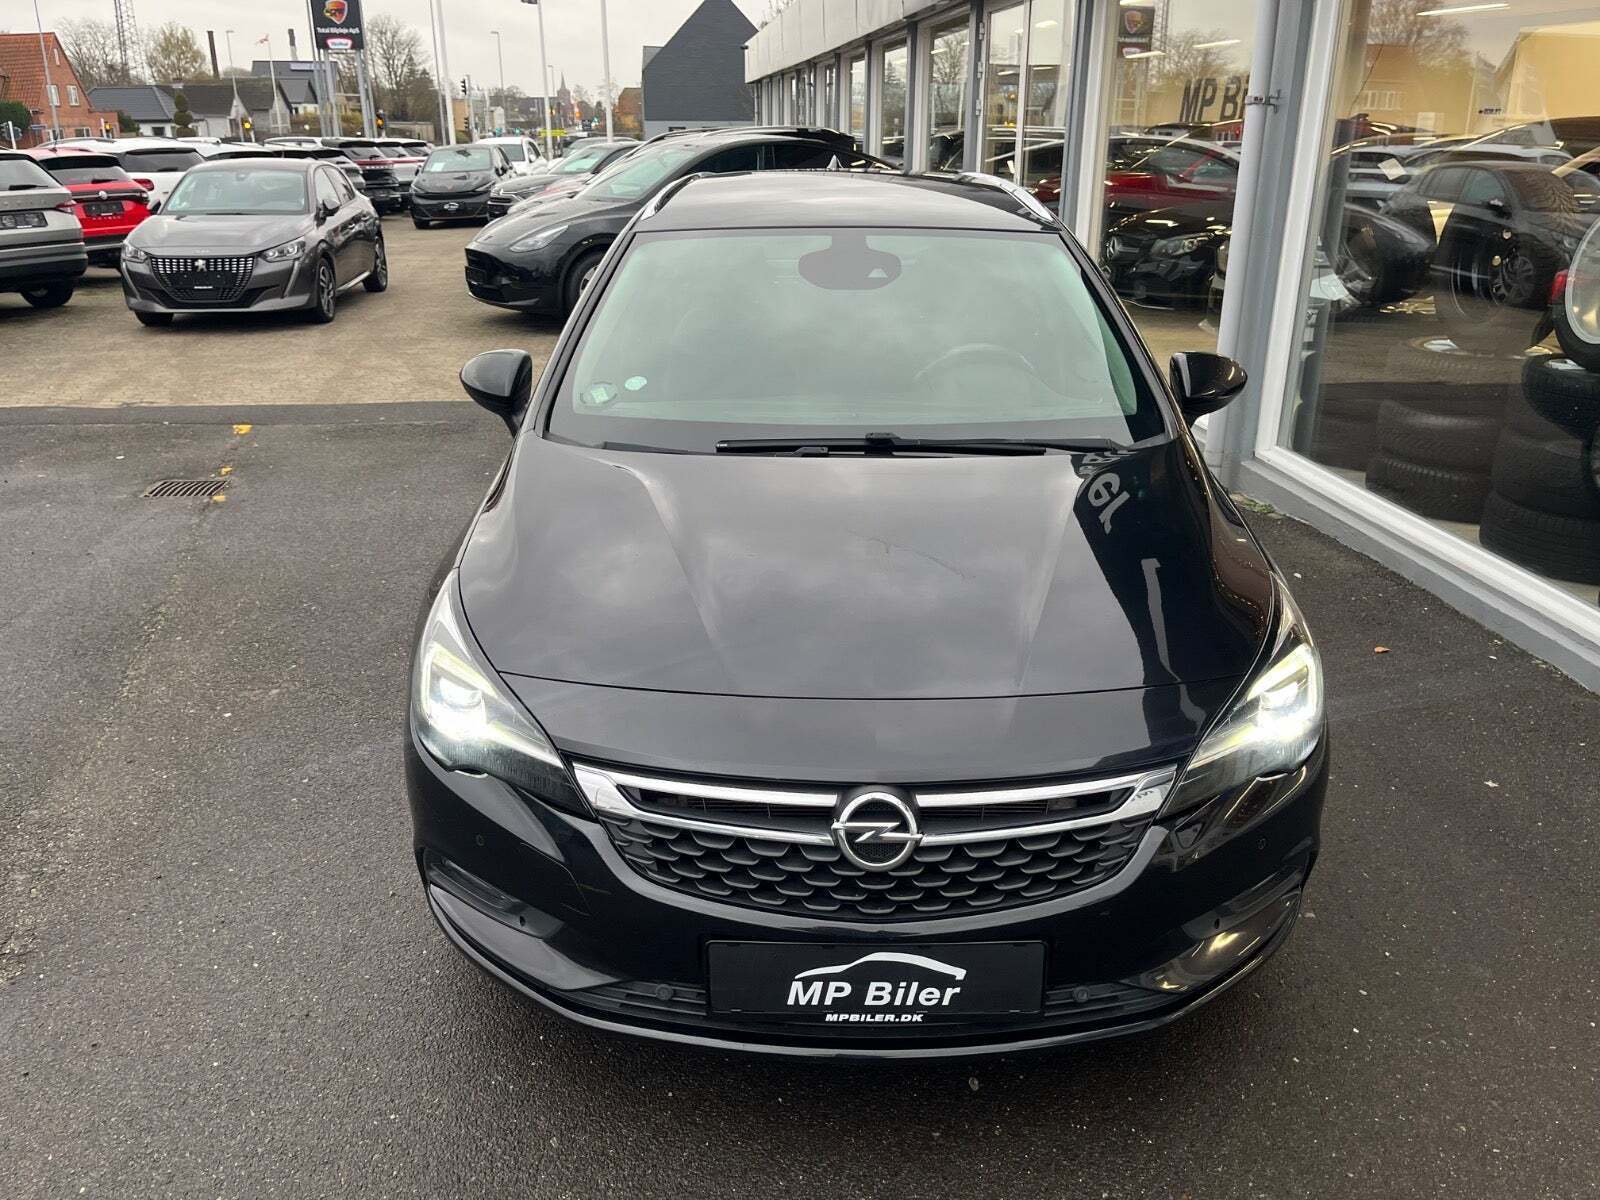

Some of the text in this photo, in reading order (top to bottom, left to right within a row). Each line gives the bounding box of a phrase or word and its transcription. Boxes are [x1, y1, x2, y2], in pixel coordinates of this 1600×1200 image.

[1179, 78, 1218, 123] MP
[786, 981, 961, 1007] MP Biler
[825, 1013, 924, 1023] MPBILER.DK
